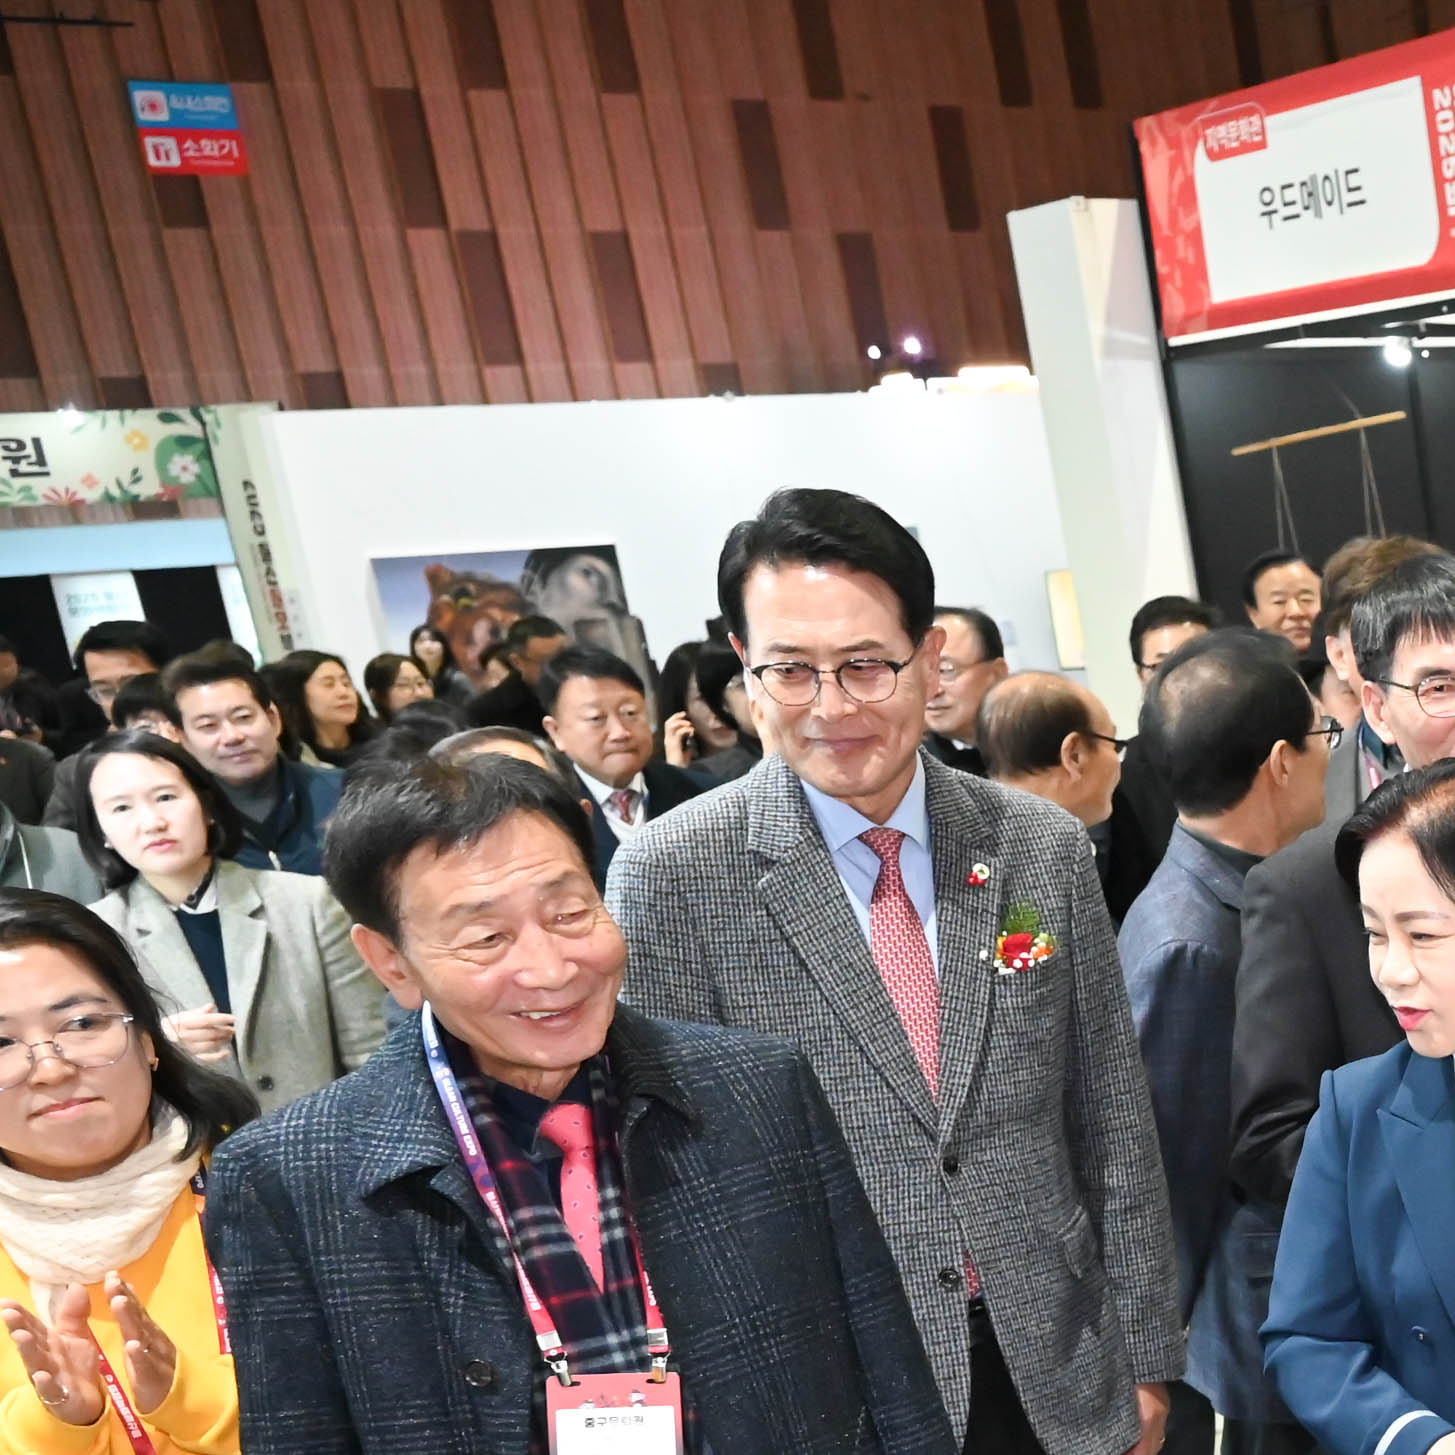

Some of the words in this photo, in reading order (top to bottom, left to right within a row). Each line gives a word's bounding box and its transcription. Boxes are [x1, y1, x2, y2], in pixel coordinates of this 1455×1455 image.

[183, 138, 240, 158] 소화기
[1259, 167, 1367, 230] 우드메이드
[0, 437, 51, 478] 원
